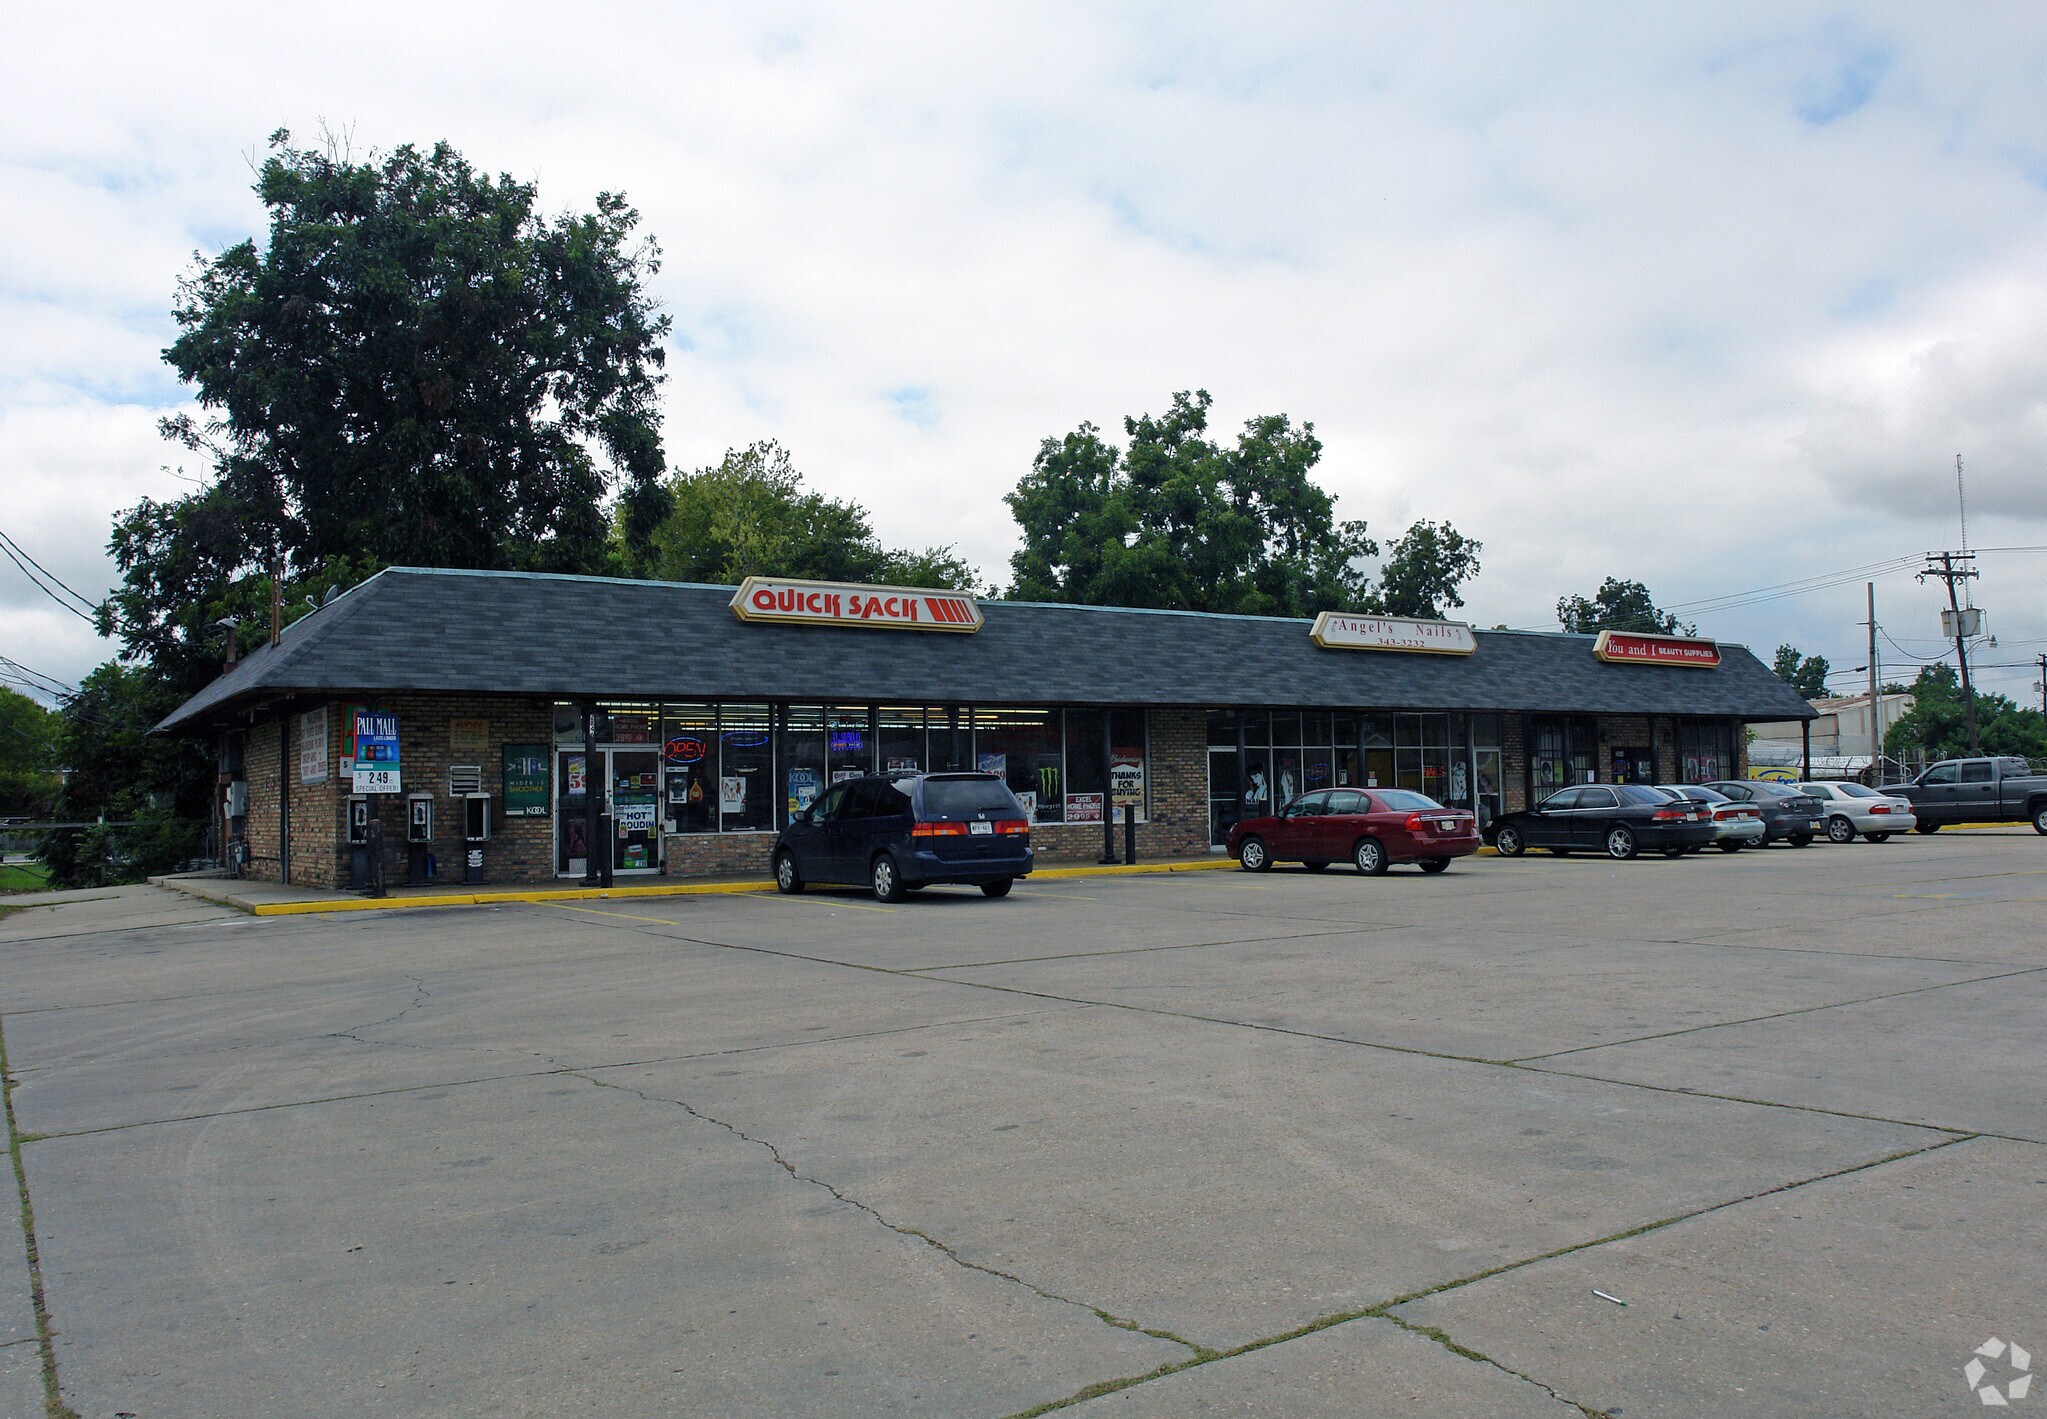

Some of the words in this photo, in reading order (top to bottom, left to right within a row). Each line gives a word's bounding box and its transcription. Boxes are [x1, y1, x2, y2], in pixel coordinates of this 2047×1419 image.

[753, 589, 841, 616] QUICK
[848, 595, 918, 622] SACK
[1338, 620, 1394, 635] Angel's
[1415, 624, 1453, 638] Nails
[1377, 637, 1425, 648] 343-3232
[1608, 640, 1624, 654] You
[1628, 643, 1647, 656] and
[1651, 644, 1656, 656] I
[1658, 647, 1683, 656] BEAUTY
[1684, 648, 1714, 658] SUPPLIES
[356, 716, 375, 736] PALL
[376, 717, 397, 737] MALL
[663, 742, 707, 758] OPEN
[790, 772, 816, 783] KOOL
[1111, 771, 1142, 780] THANKS
[356, 785, 378, 793] SPECIAL
[1117, 780, 1134, 788] FOR
[526, 806, 547, 815] KOOL
